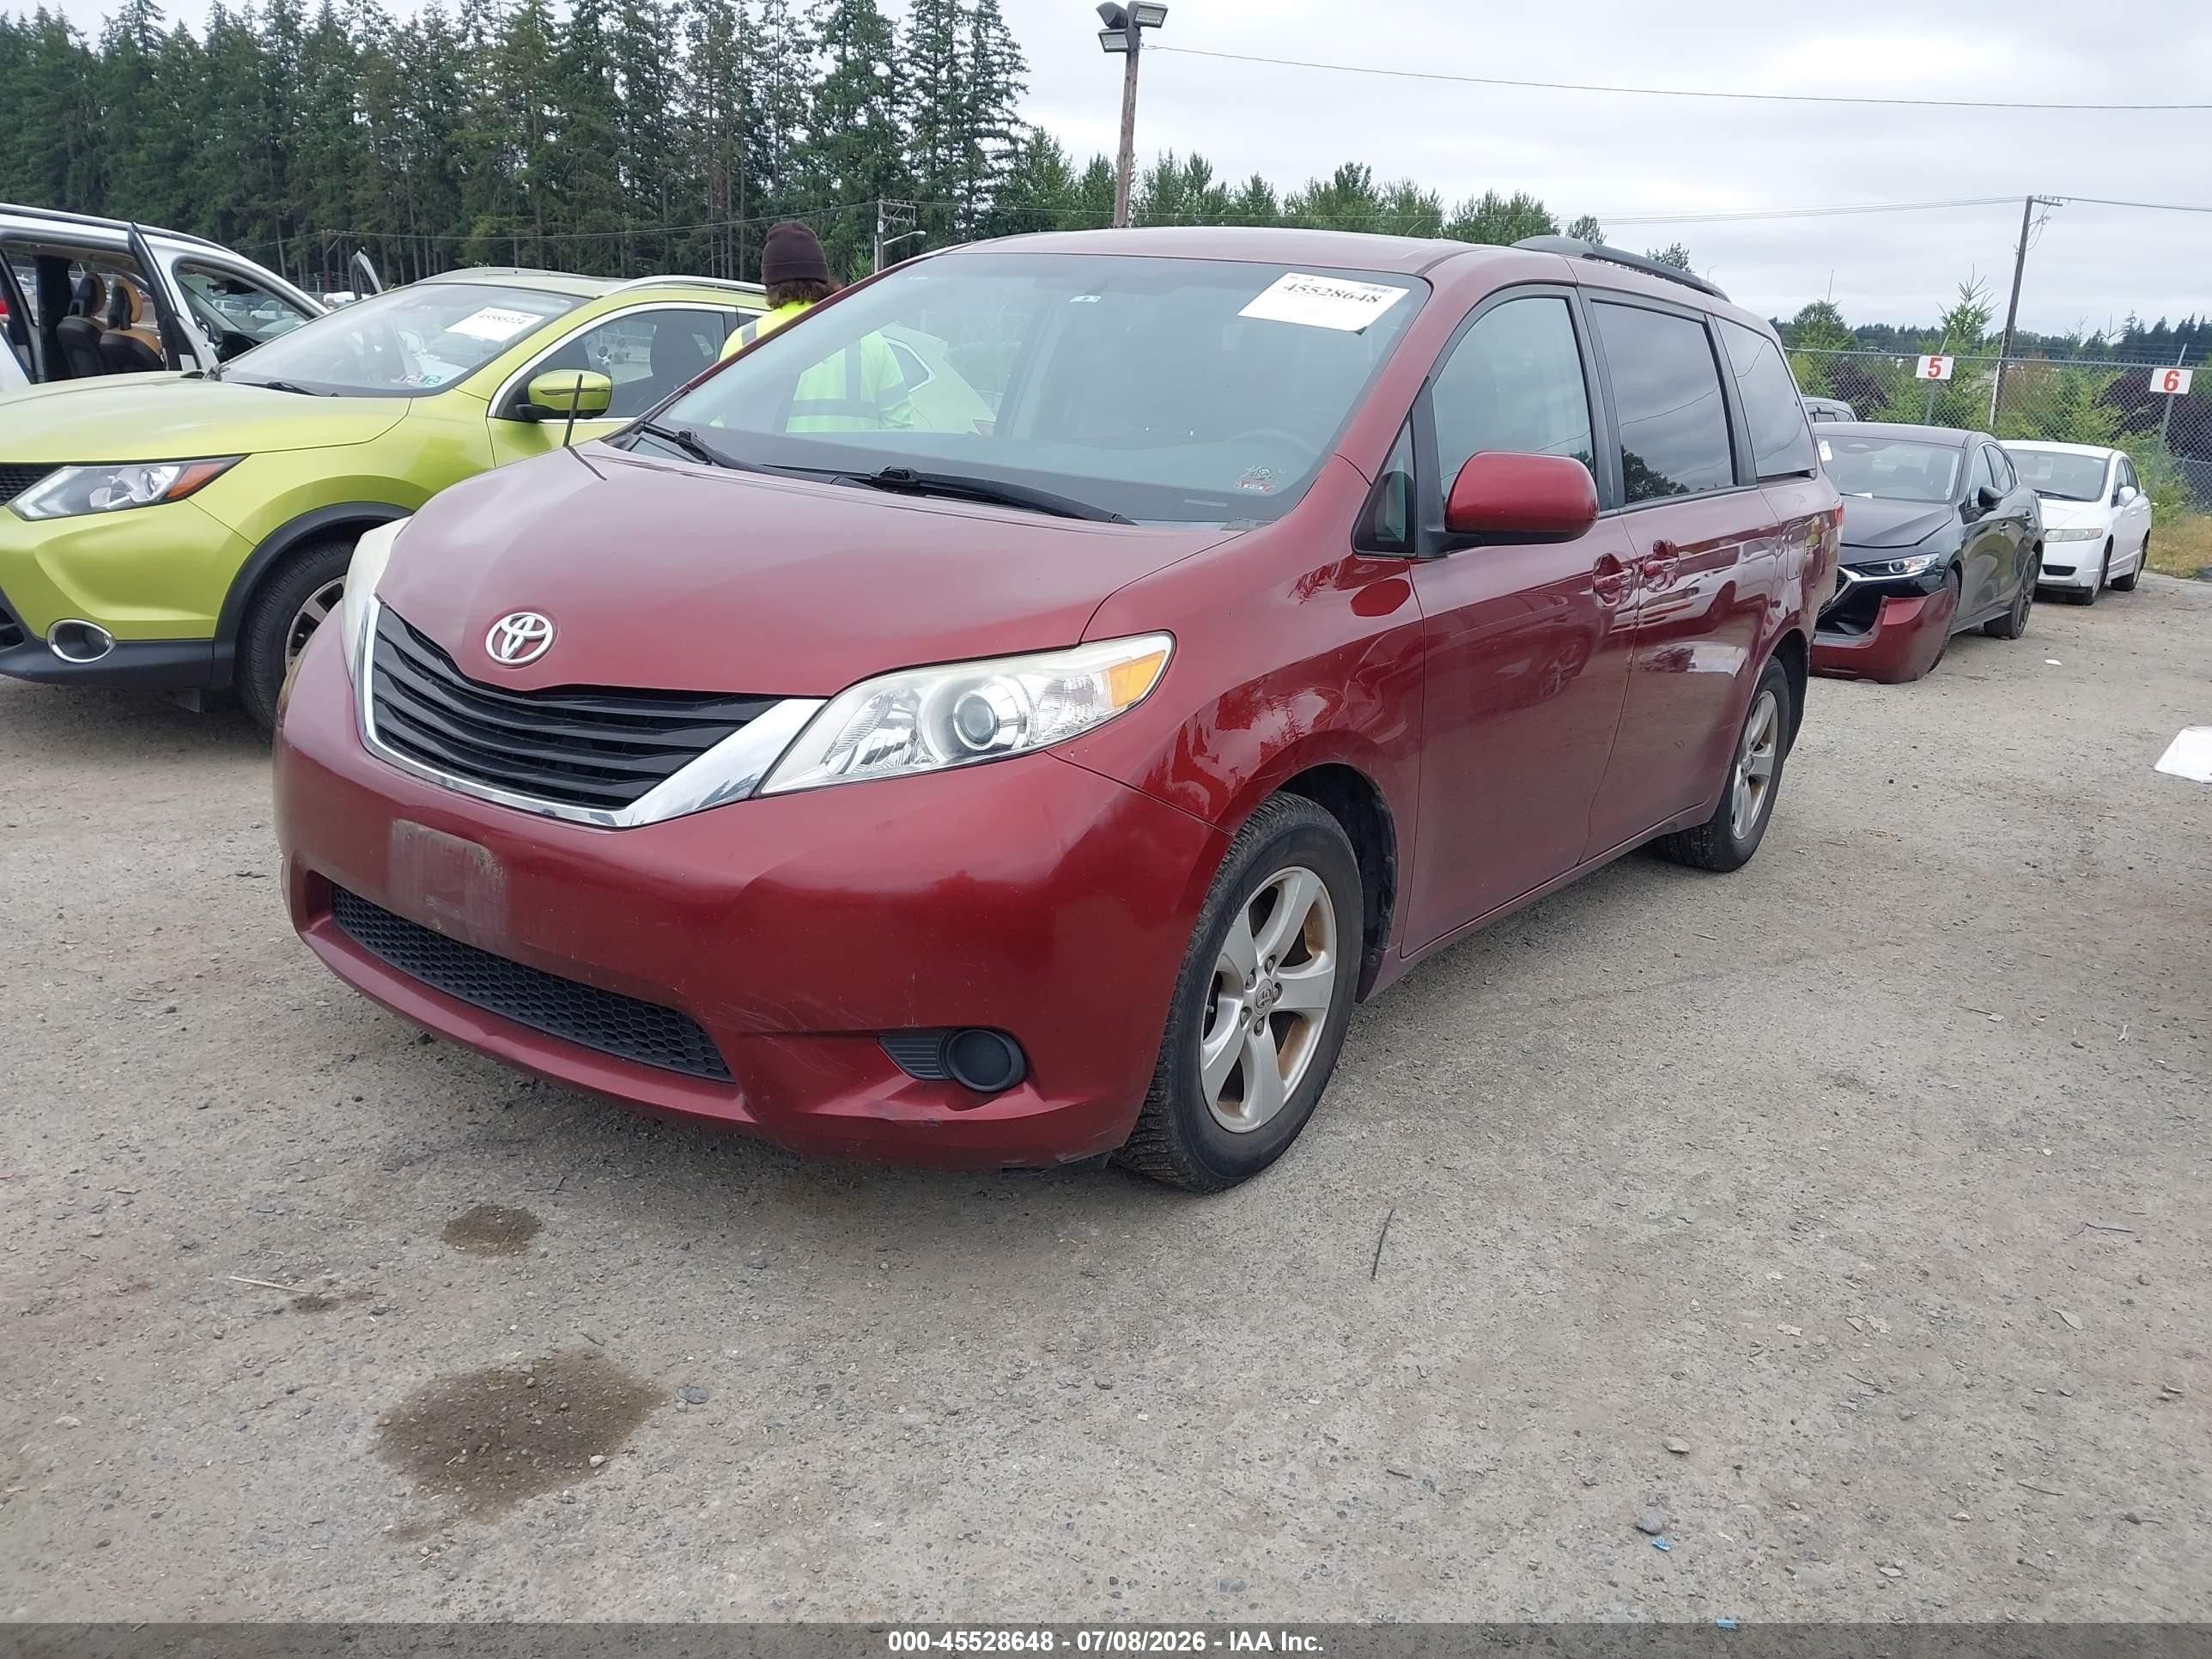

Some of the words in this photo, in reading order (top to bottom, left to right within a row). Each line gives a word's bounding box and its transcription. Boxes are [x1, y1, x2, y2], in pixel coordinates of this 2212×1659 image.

[1283, 283, 1382, 303] 45528648
[1927, 357, 1942, 378] 5
[2163, 369, 2181, 392] 6
